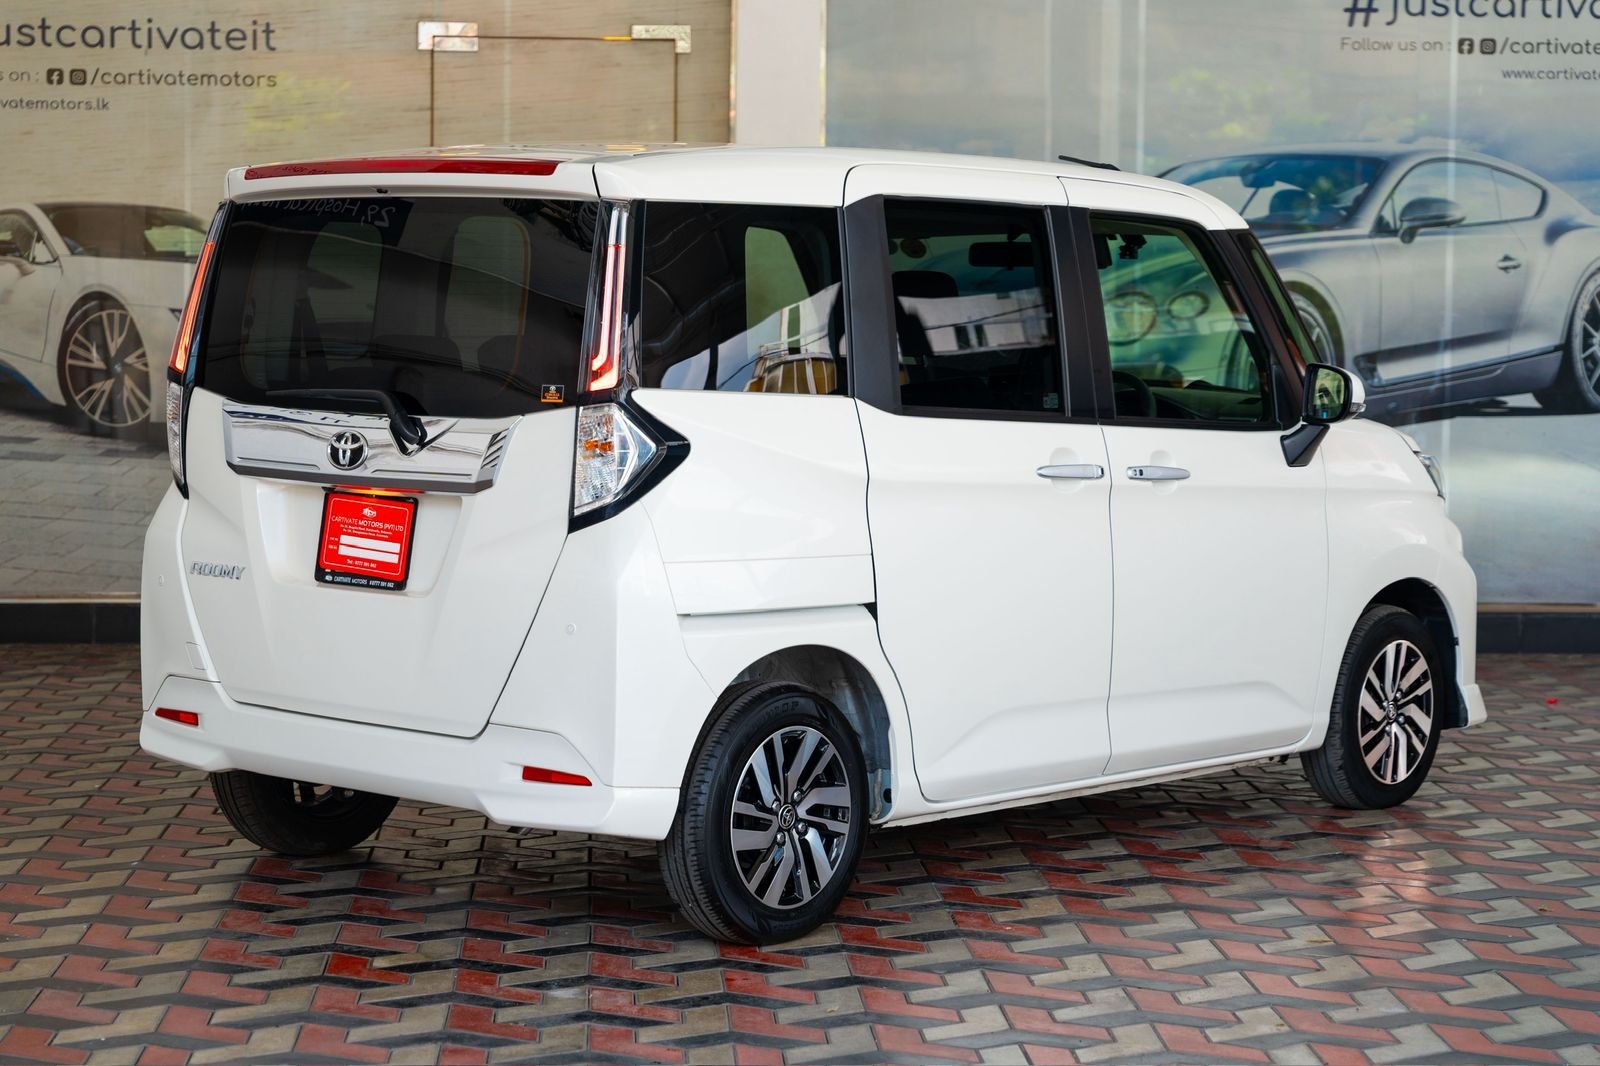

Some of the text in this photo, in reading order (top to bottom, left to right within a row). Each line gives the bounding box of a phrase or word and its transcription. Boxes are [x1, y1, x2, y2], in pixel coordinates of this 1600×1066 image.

[1340, 37, 1393, 51] Follow
[1398, 41, 1417, 51] us
[1422, 41, 1444, 51] on
[9, 71, 31, 82] on
[90, 67, 277, 88] /cartivatemotors
[1502, 67, 1600, 80] www.cartivat
[331, 515, 358, 525] CARTIVATE
[358, 520, 383, 529] MOTORS
[190, 561, 246, 580] ROOMY
